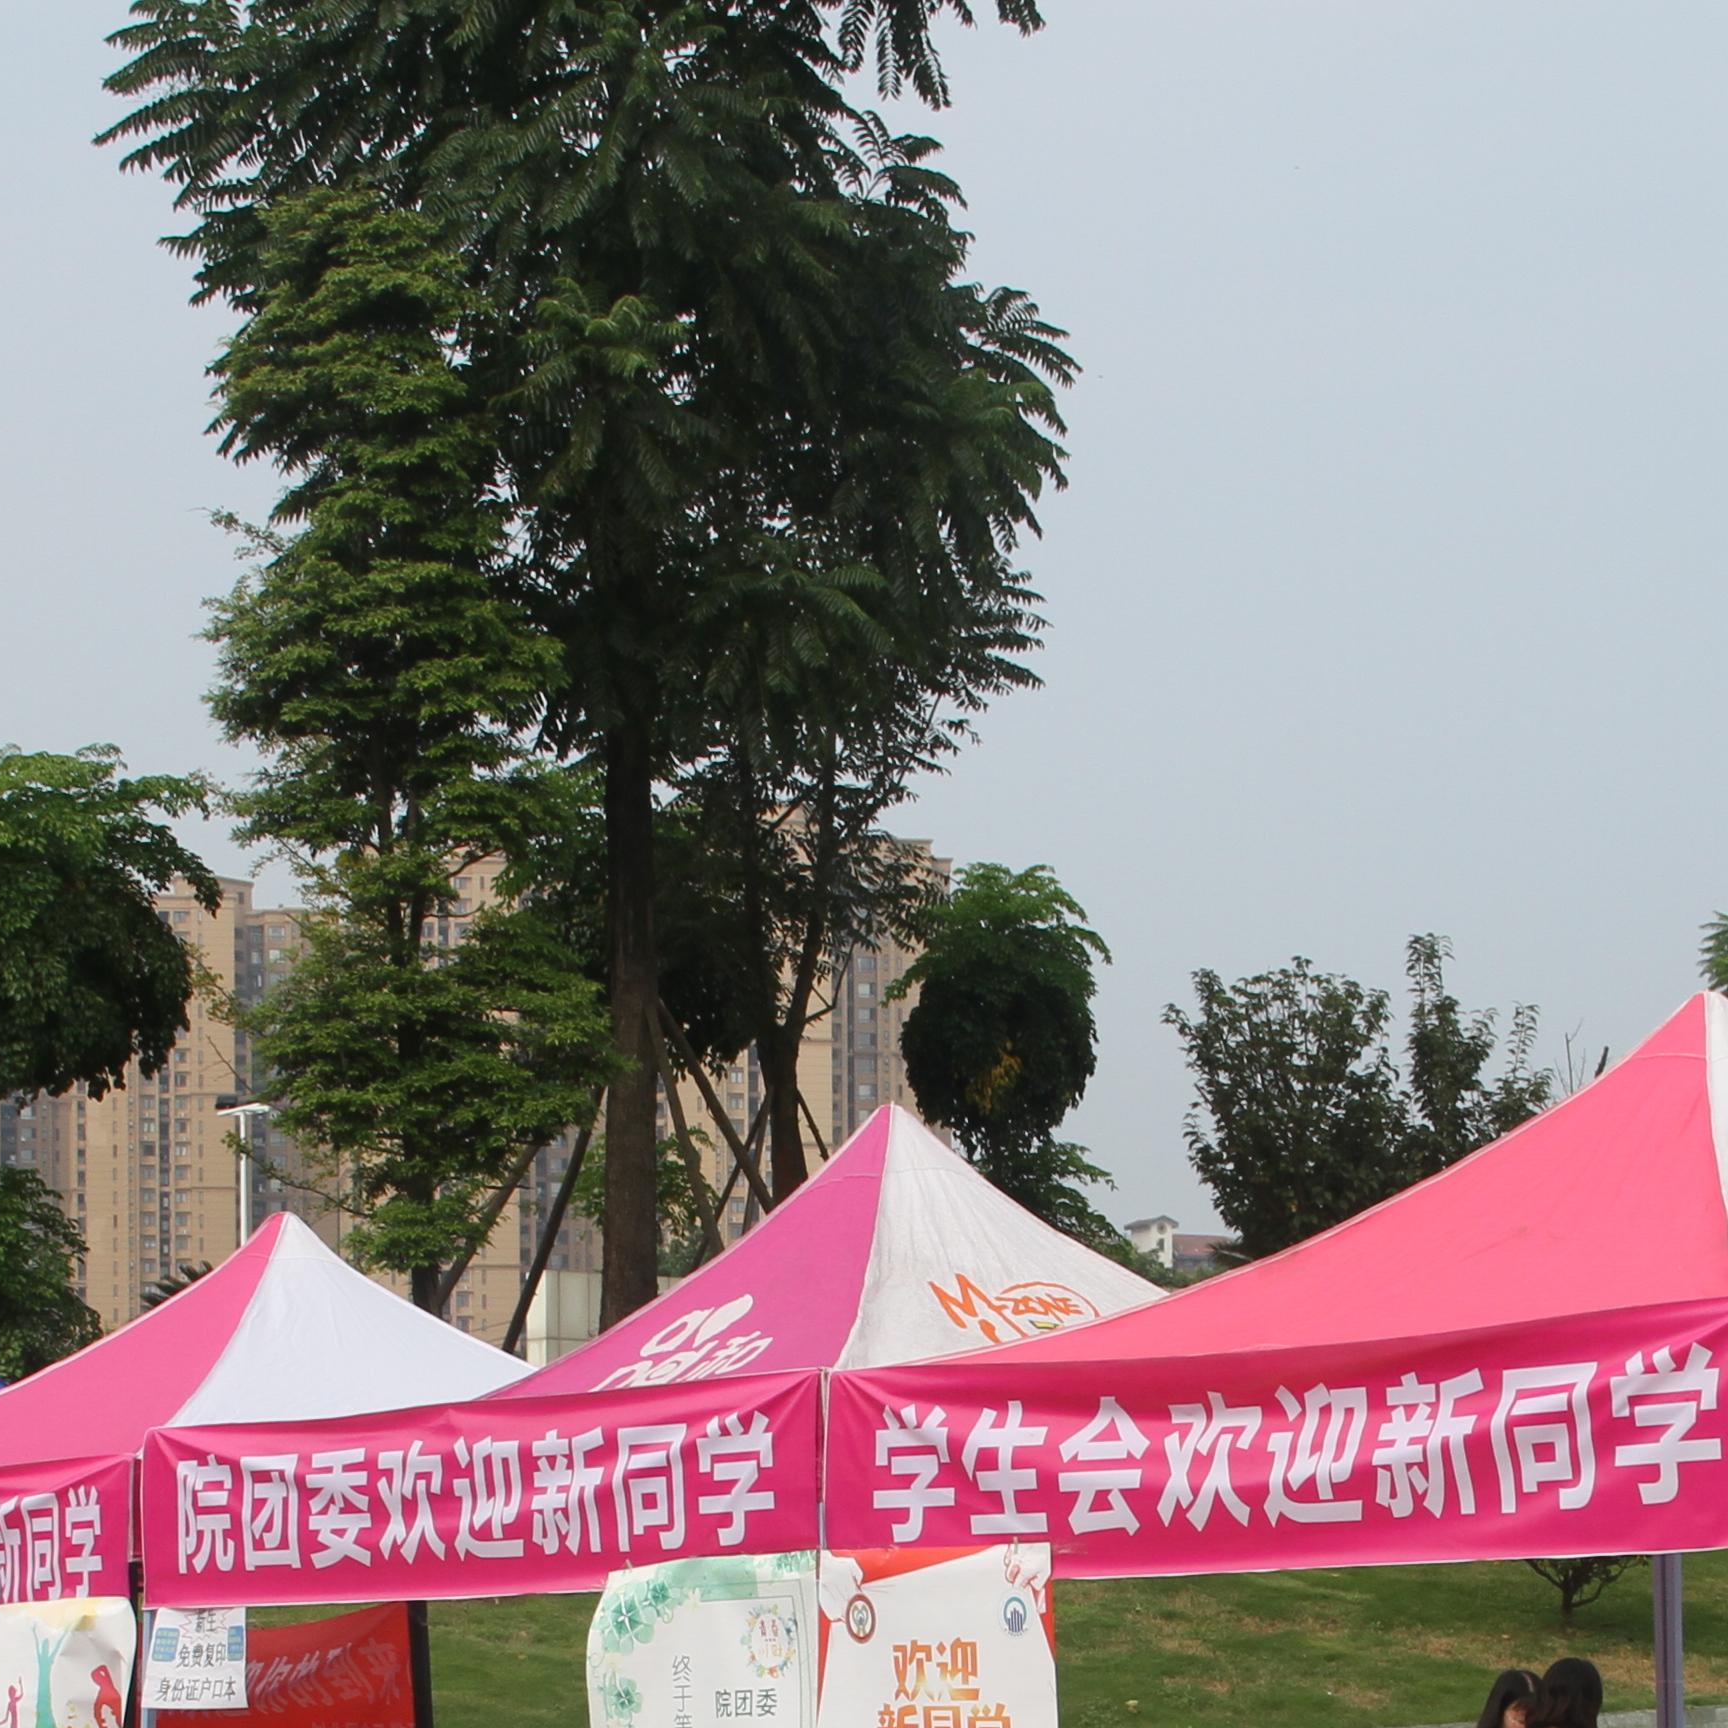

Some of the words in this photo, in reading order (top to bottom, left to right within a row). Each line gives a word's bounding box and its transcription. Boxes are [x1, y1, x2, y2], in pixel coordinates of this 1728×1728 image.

[873, 1343, 1722, 1544] 学生会欢迎新同学
[176, 1411, 775, 1574] 院团委欢迎新同学
[176, 1642, 227, 1668] 免费复印
[892, 1636, 981, 1702] 欢迎
[155, 1675, 237, 1702] 身份证户口本
[715, 1688, 778, 1718] 院团委
